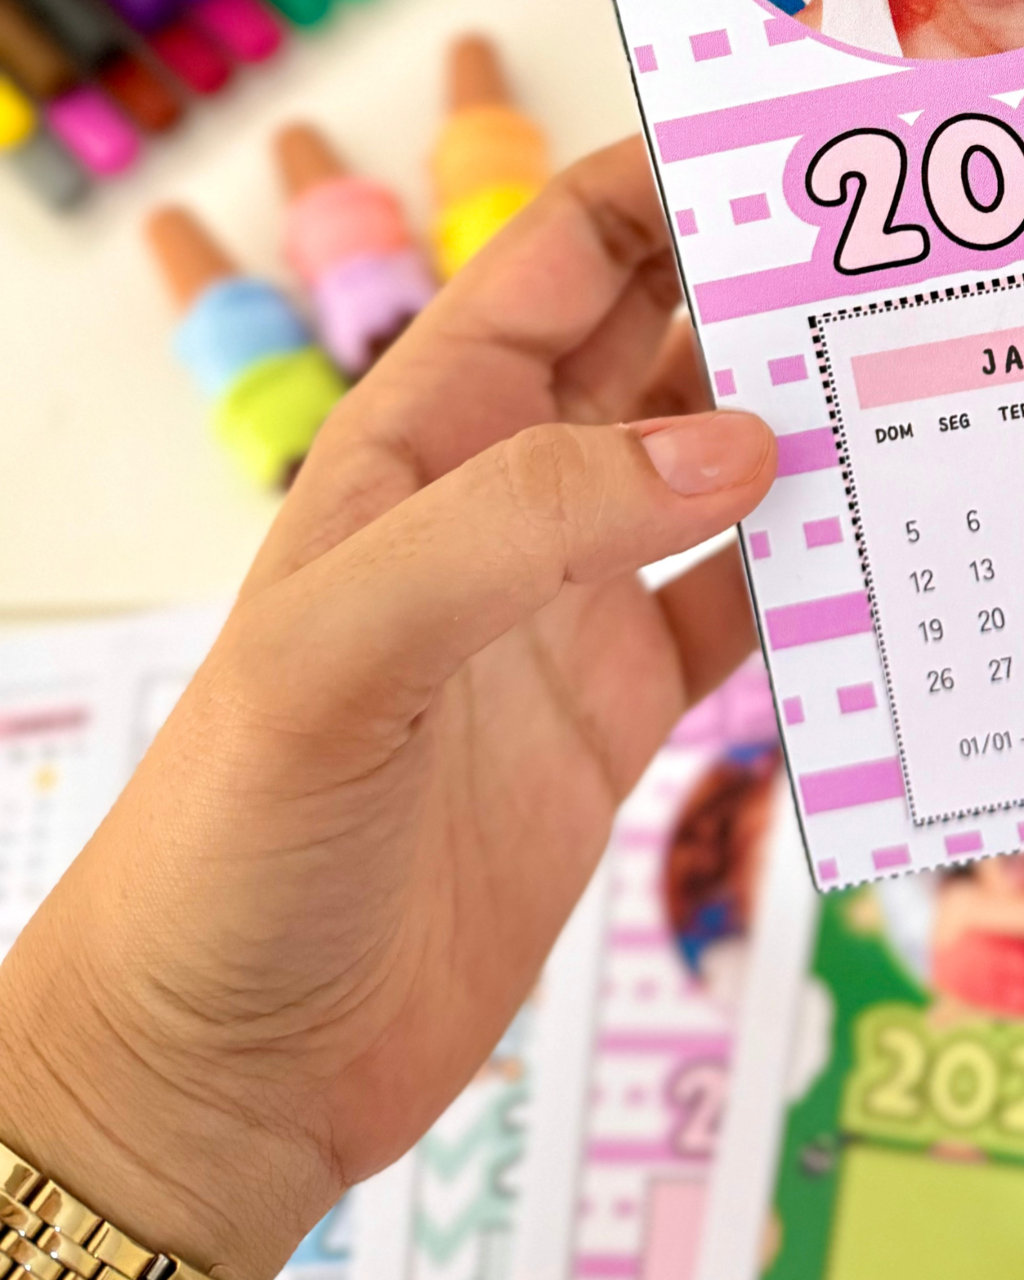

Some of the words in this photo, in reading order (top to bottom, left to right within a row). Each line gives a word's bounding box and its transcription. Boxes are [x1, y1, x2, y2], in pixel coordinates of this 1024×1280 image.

[875, 423, 914, 445] DOM
[938, 412, 971, 433] SEG
[905, 520, 921, 544] 5
[966, 509, 981, 534] 6
[910, 568, 936, 594] 12
[969, 558, 996, 583] 13
[918, 618, 944, 644] 19
[977, 607, 1006, 633] 20
[926, 667, 955, 694] 26
[988, 656, 1013, 683] 27
[959, 730, 1013, 758] 01/01
